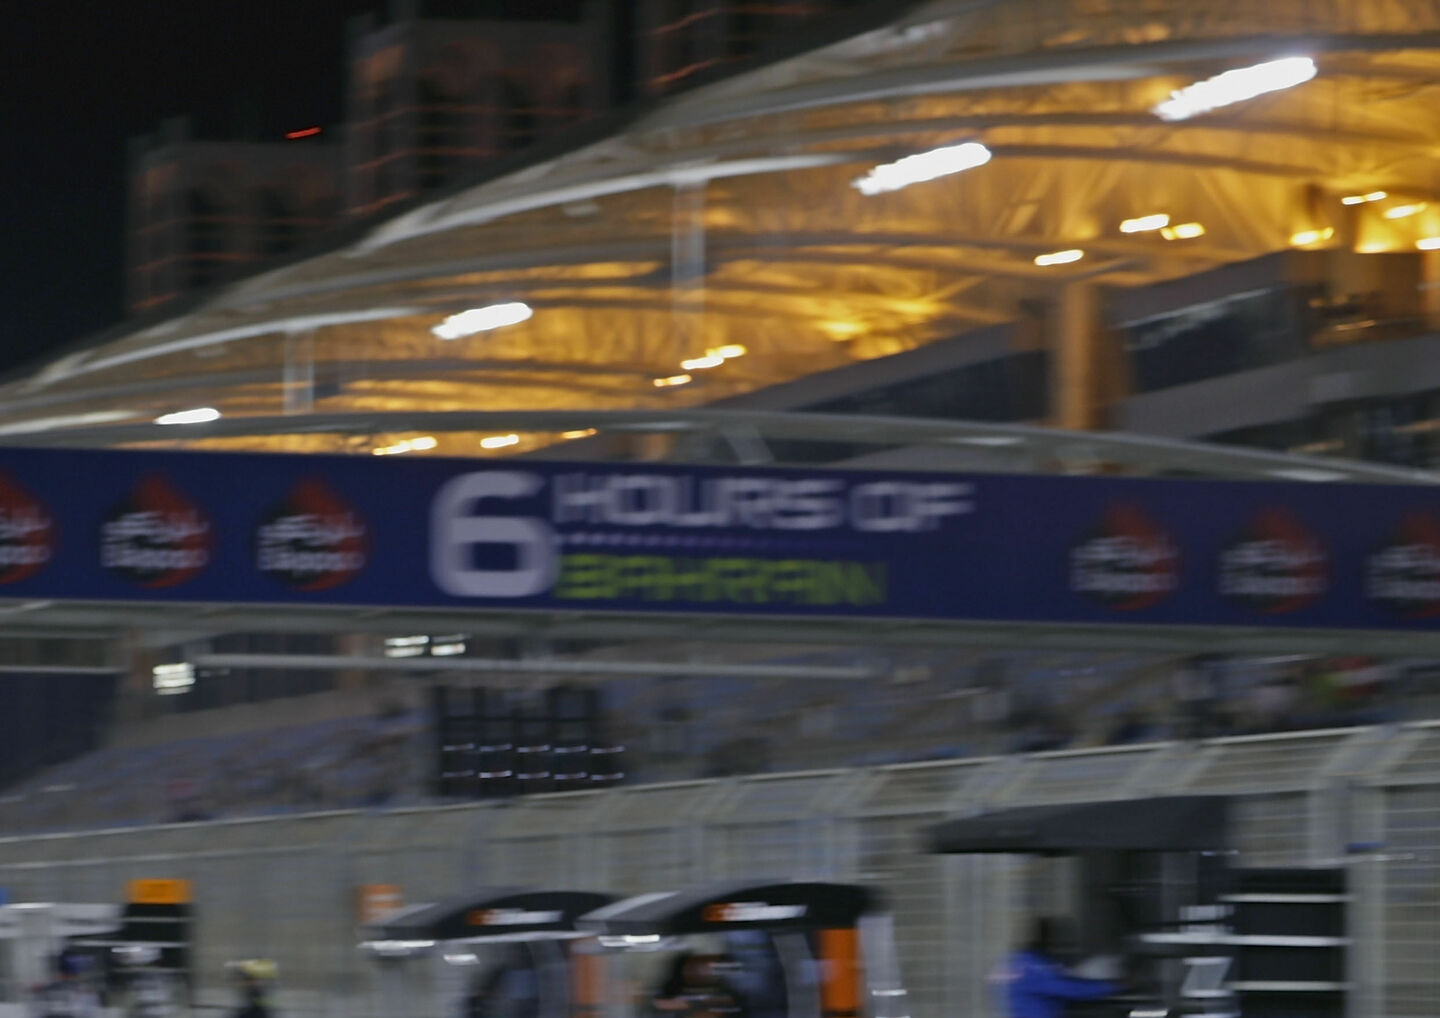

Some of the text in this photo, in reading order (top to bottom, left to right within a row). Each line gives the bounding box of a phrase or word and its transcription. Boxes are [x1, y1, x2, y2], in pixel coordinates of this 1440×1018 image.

[428, 470, 560, 597] 6
[553, 473, 845, 530] HOURS
[851, 480, 976, 532] OF
